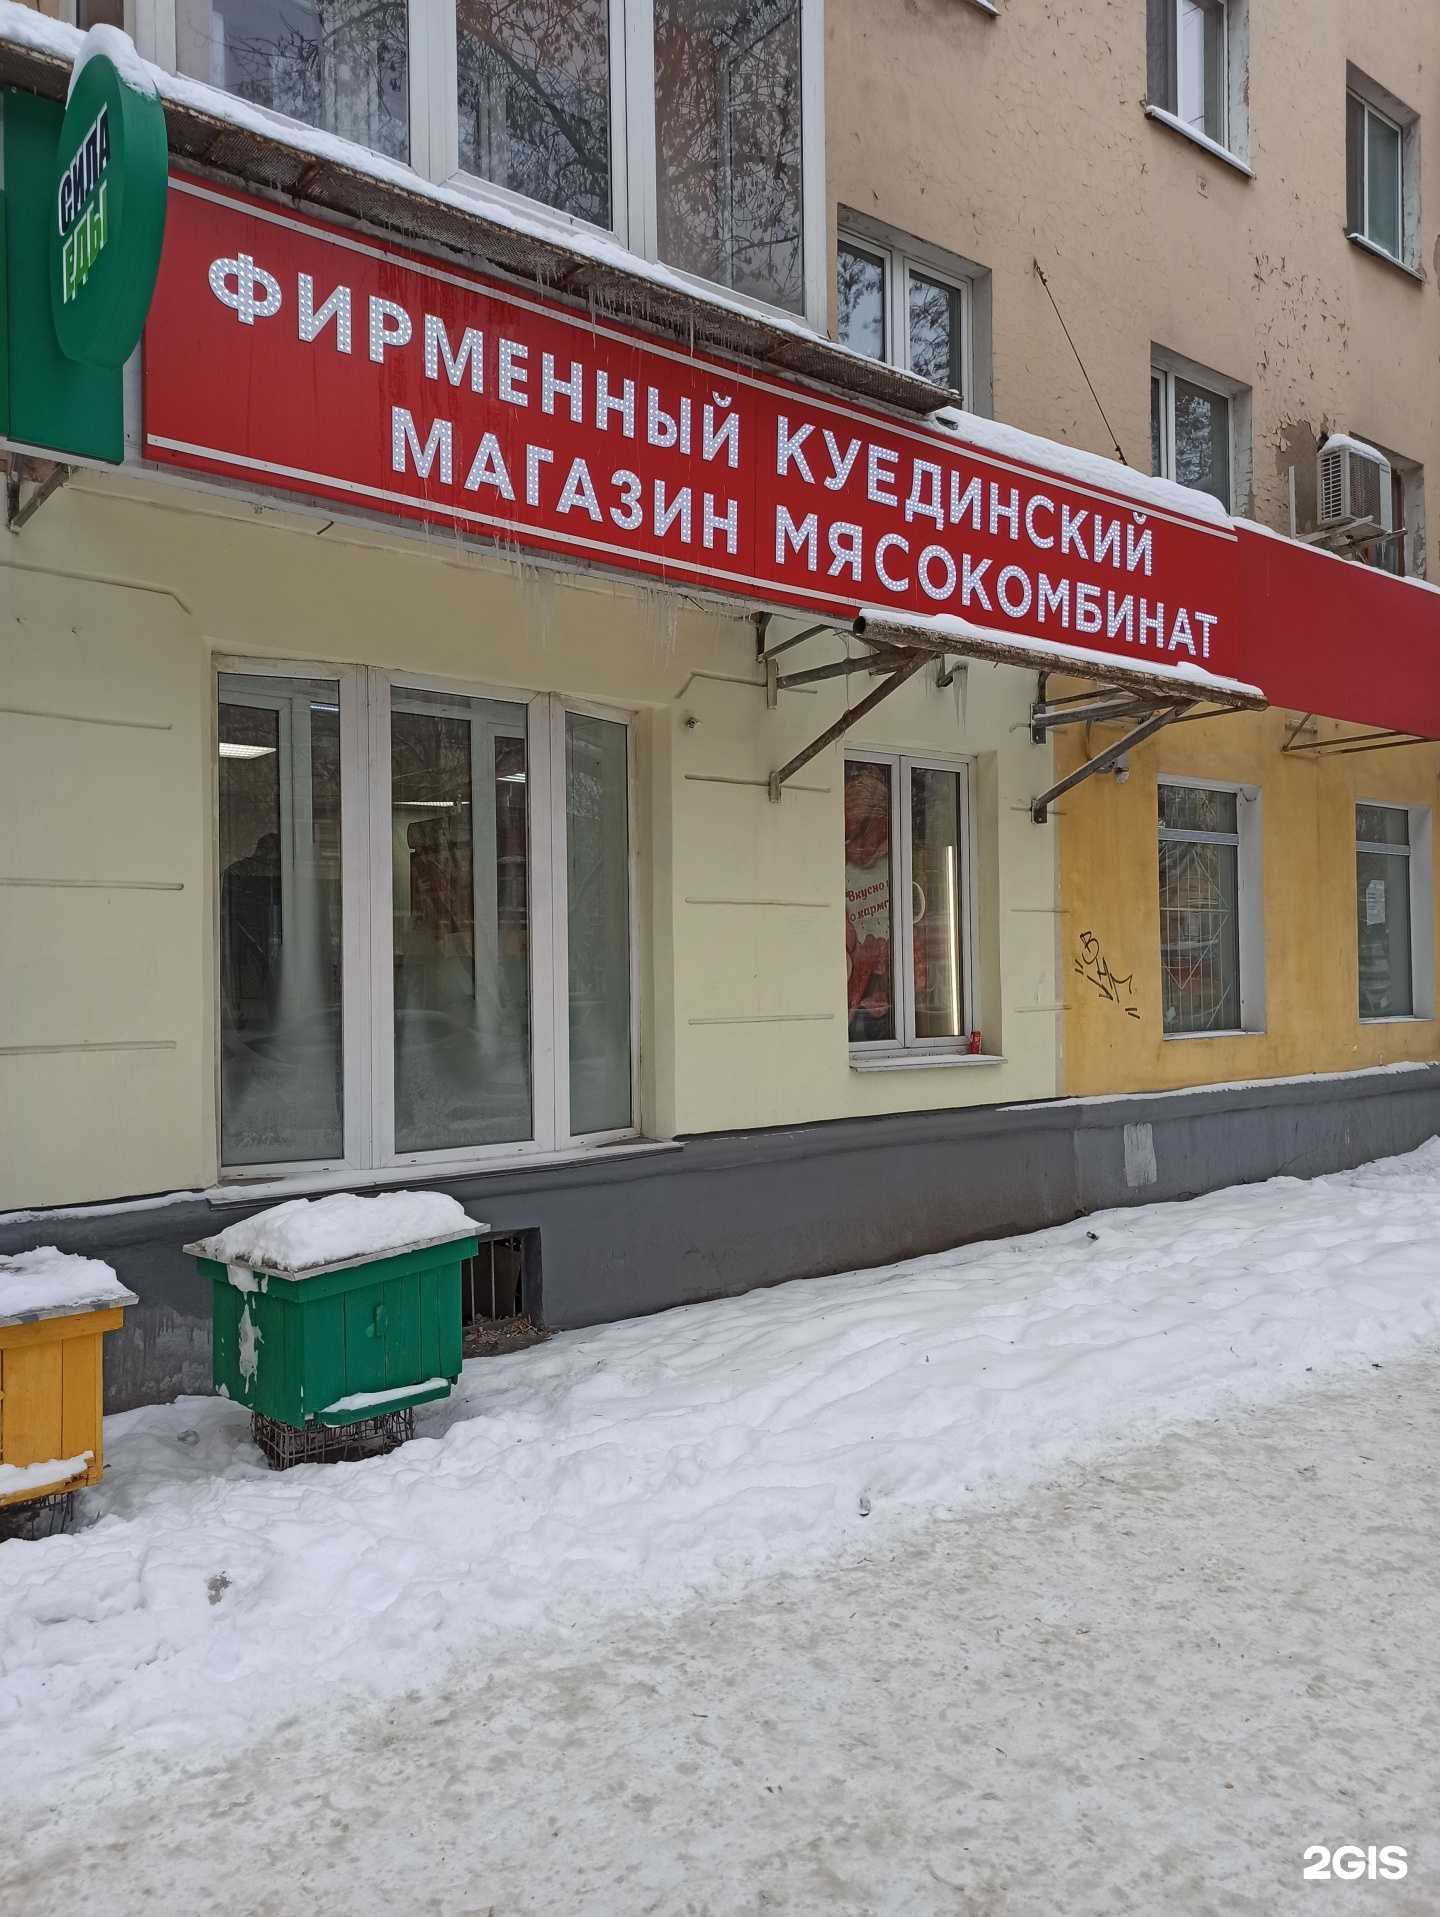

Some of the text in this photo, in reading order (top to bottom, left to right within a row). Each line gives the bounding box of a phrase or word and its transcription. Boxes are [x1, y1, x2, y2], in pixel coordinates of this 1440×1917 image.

[59, 102, 110, 236] СИЛА
[63, 180, 107, 304] ЕДЫ
[208, 253, 1153, 576] ФИРМЕННЫЙ КУЕДИНСКИЙ
[391, 405, 1218, 658] МАГАЗИН МЯСОКОМБИНАТ
[848, 882, 885, 902] Вкусно
